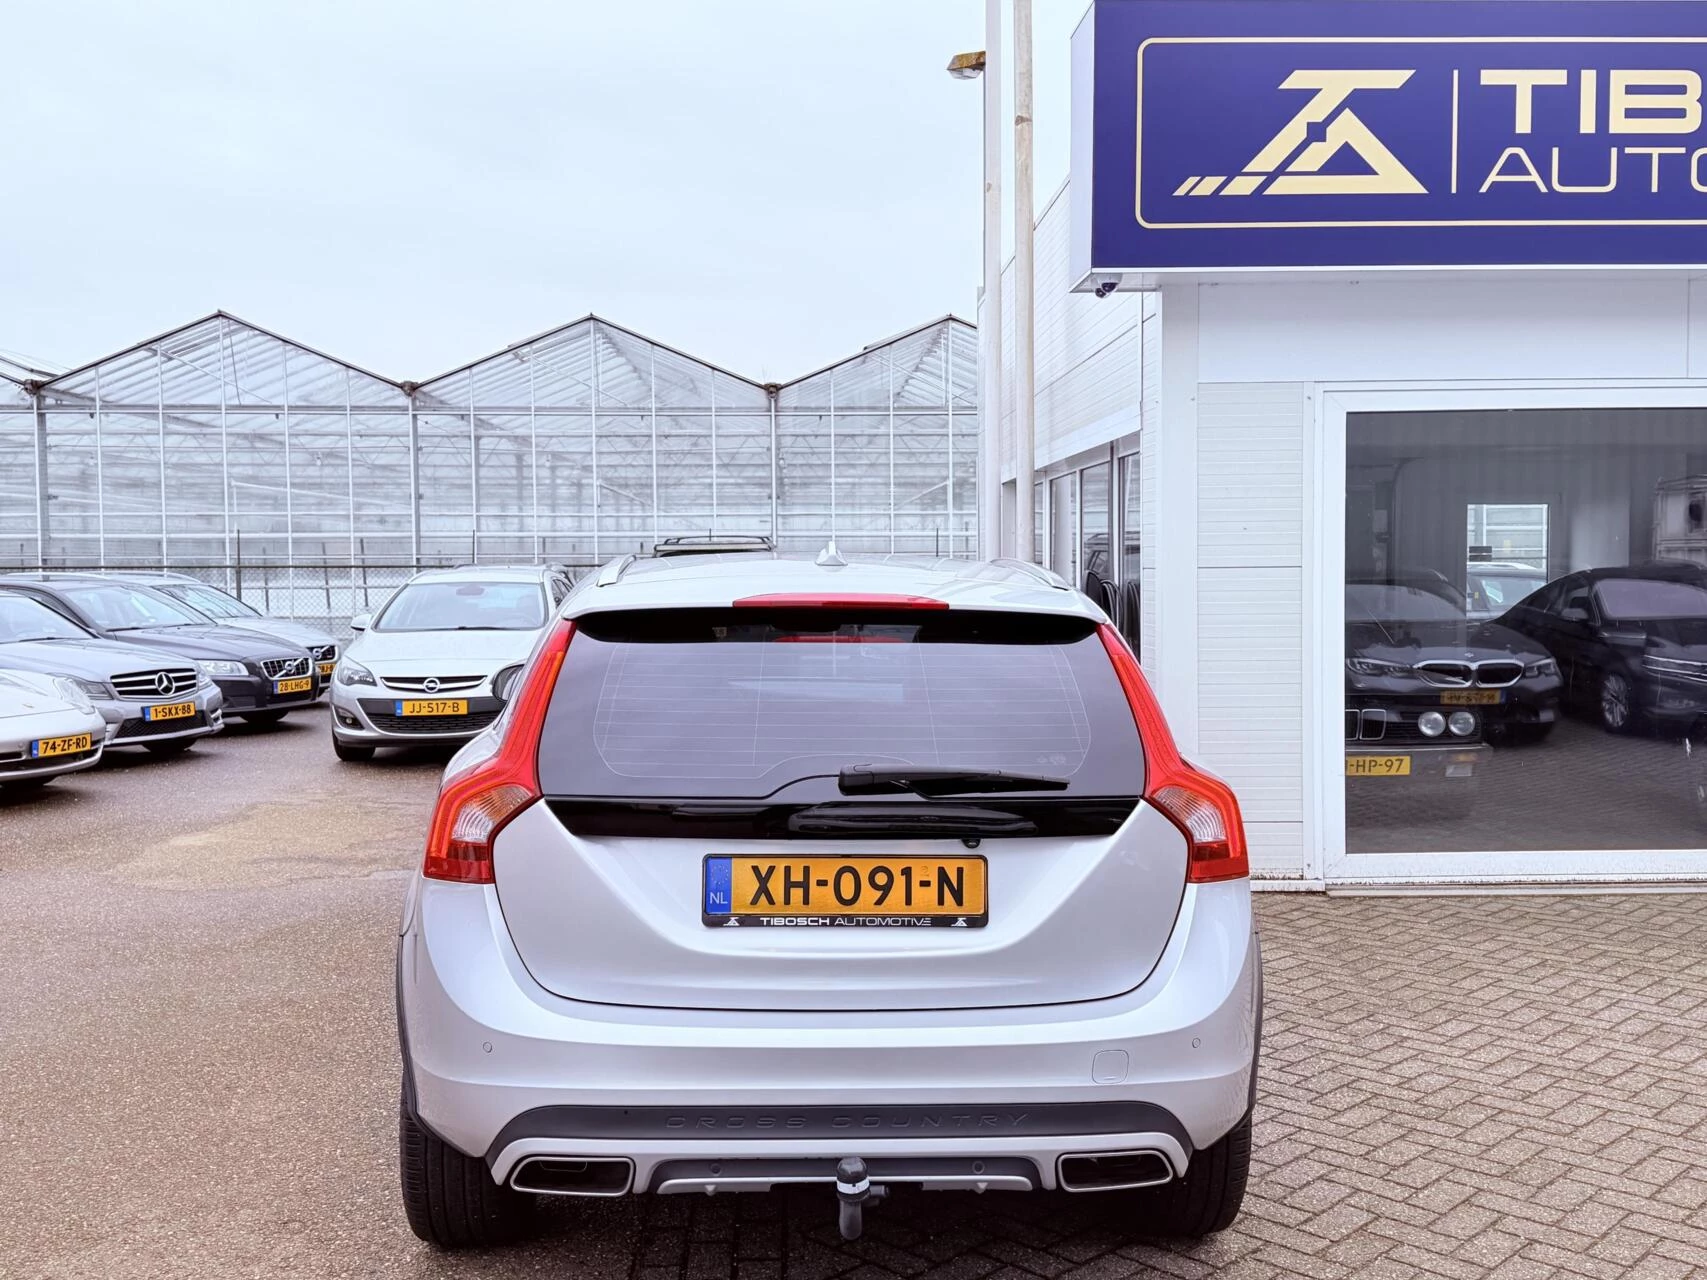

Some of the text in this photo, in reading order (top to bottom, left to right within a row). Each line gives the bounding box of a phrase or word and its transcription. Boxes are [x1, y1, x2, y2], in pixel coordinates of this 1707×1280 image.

[1480, 69, 1702, 134] TIB
[1478, 147, 1707, 193] AUT
[154, 704, 192, 718] 1-SKX-88
[409, 702, 460, 714] JJ-517-B
[42, 737, 88, 754] 74-ZF-RD
[1345, 759, 1405, 773] -HP-97
[750, 865, 964, 907] XH-091-N
[710, 891, 728, 904] NL
[760, 917, 932, 926] TIBOSCH AUTOMOTIVE
[664, 1113, 1029, 1129] CROSS COUNTRY
